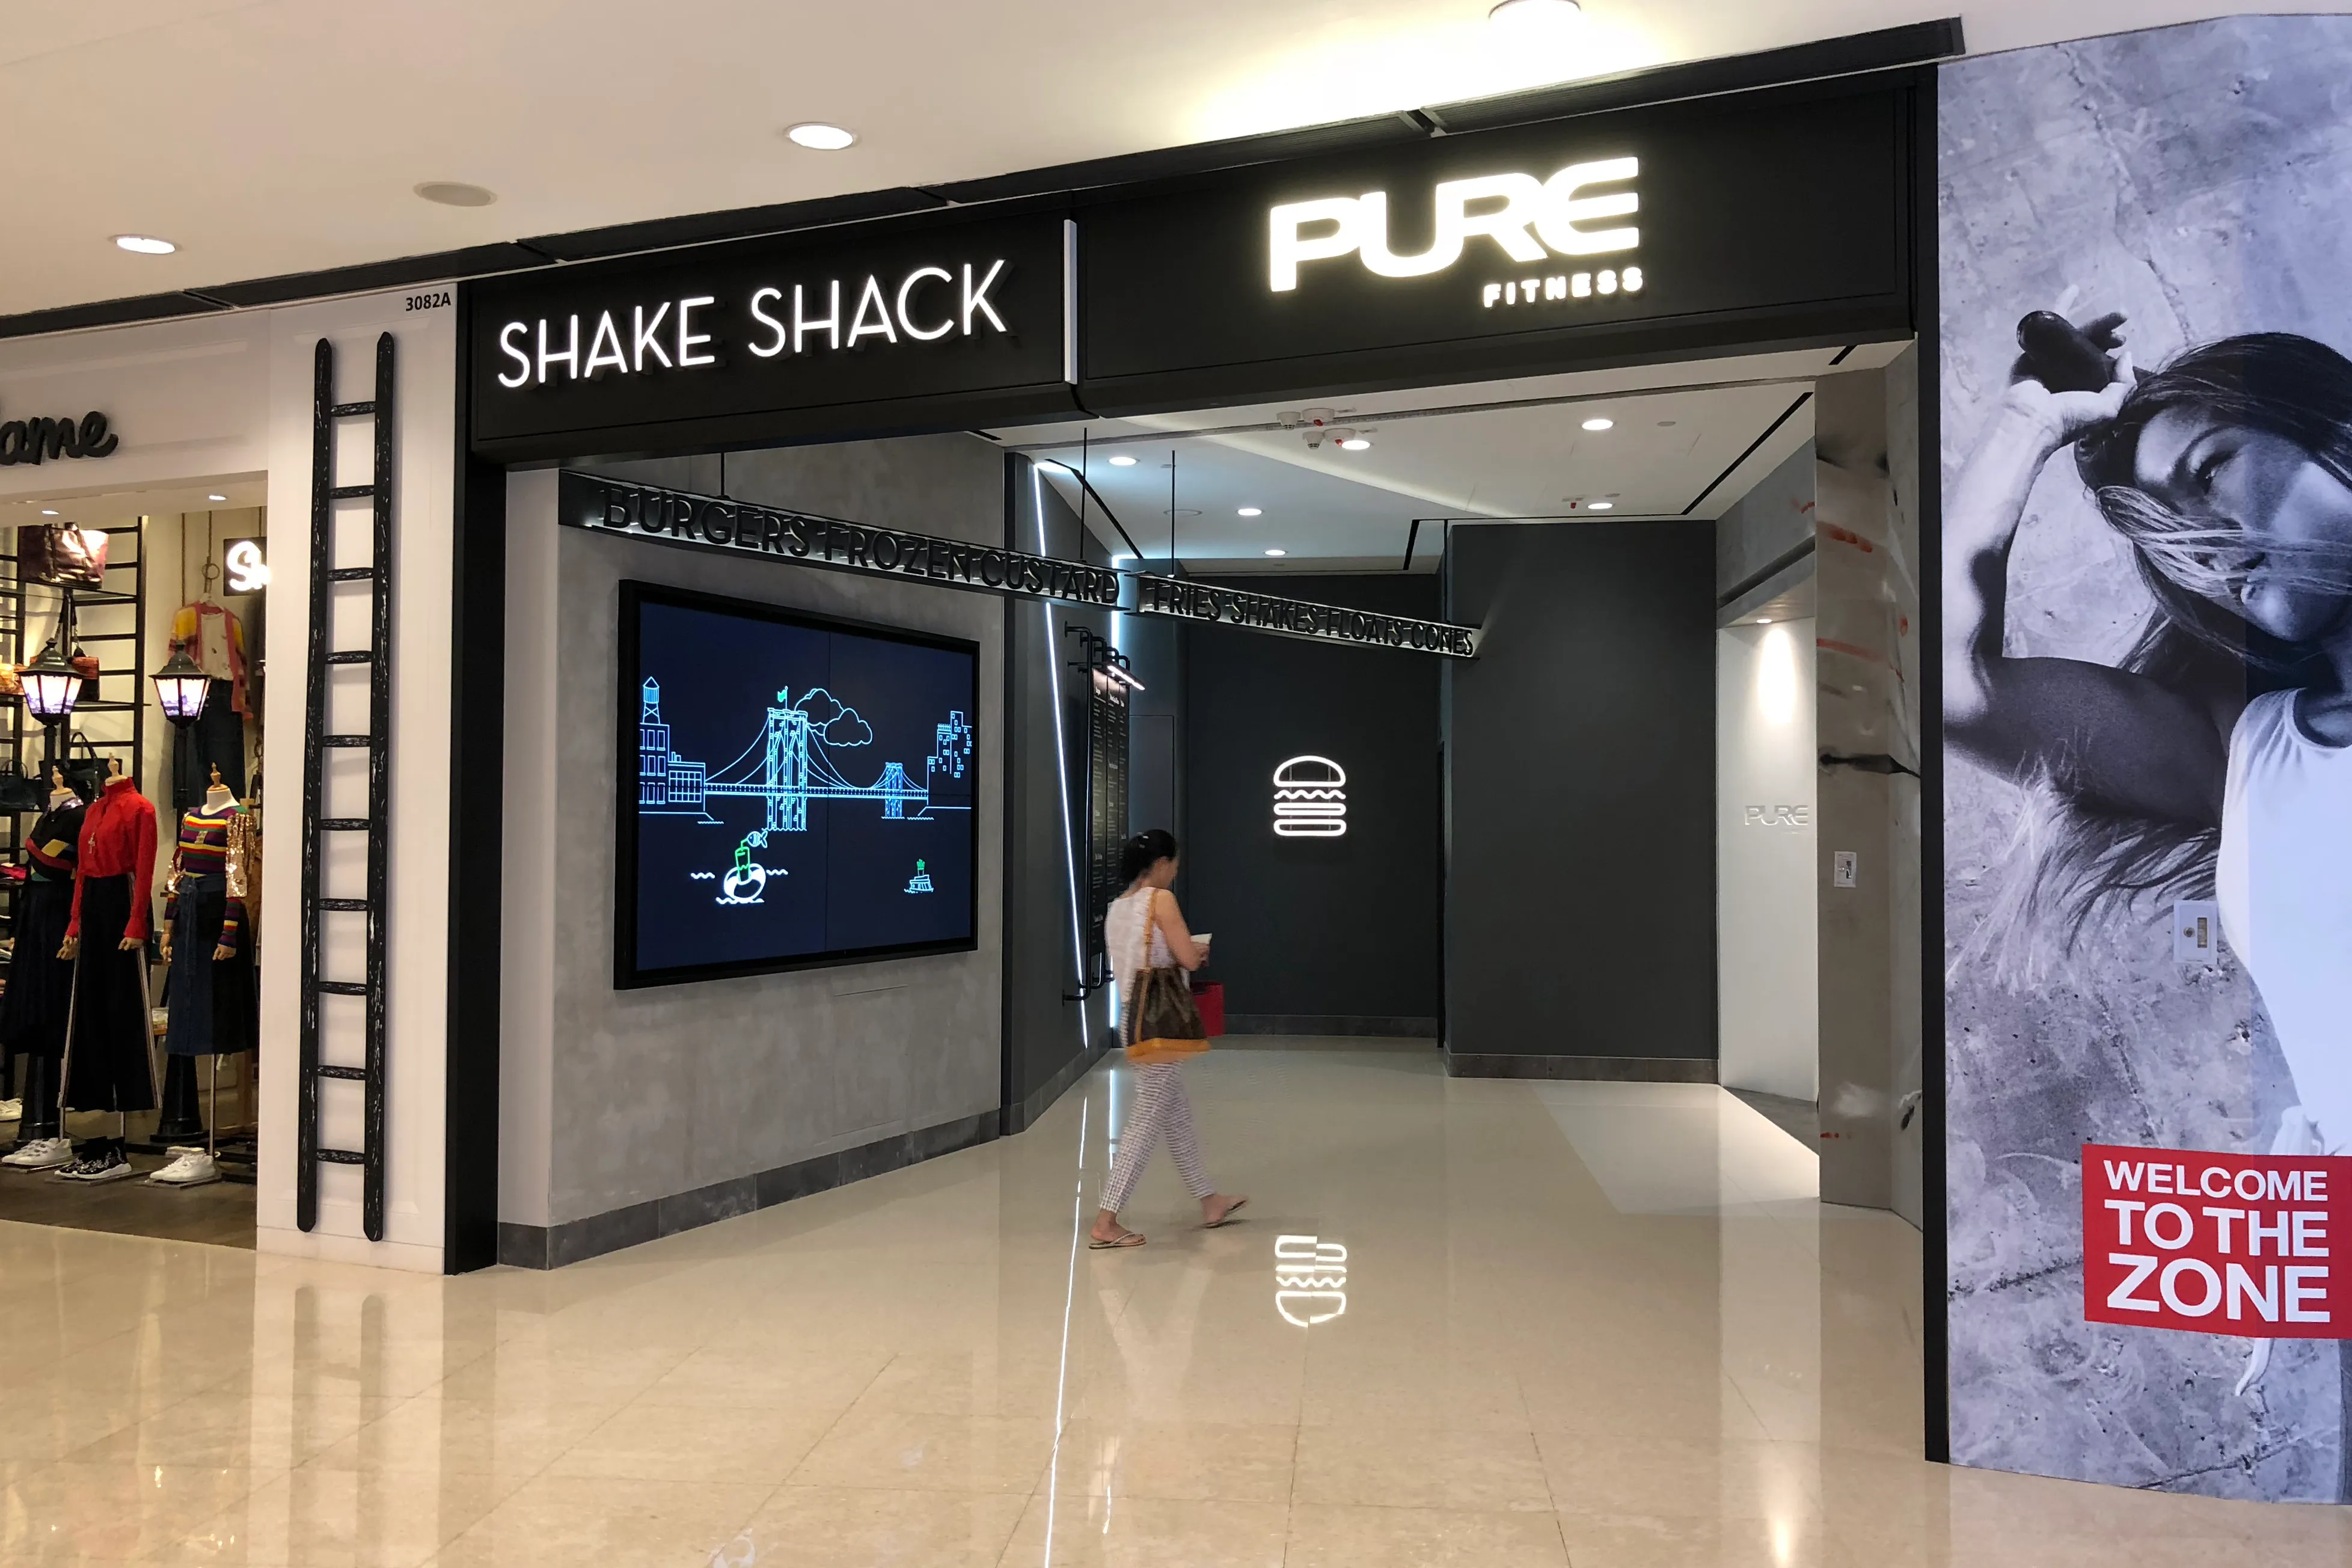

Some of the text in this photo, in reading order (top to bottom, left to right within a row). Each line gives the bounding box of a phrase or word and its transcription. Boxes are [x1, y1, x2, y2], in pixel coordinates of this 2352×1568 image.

[1270, 156, 1639, 292] PURE
[405, 292, 452, 311] 3082A
[1483, 266, 1644, 308] FITNESS
[498, 259, 1008, 388] SHAKE SHACK
[603, 483, 1119, 604] BURGERS FROZEN CUSTARD
[1153, 580, 1474, 655] FRIES SHAKES FLOATS CONES
[1744, 804, 1808, 826] PURE
[2103, 1159, 2329, 1201] WELCOME
[2104, 1199, 2329, 1257] TO THE
[2107, 1252, 2330, 1323] ZONE
